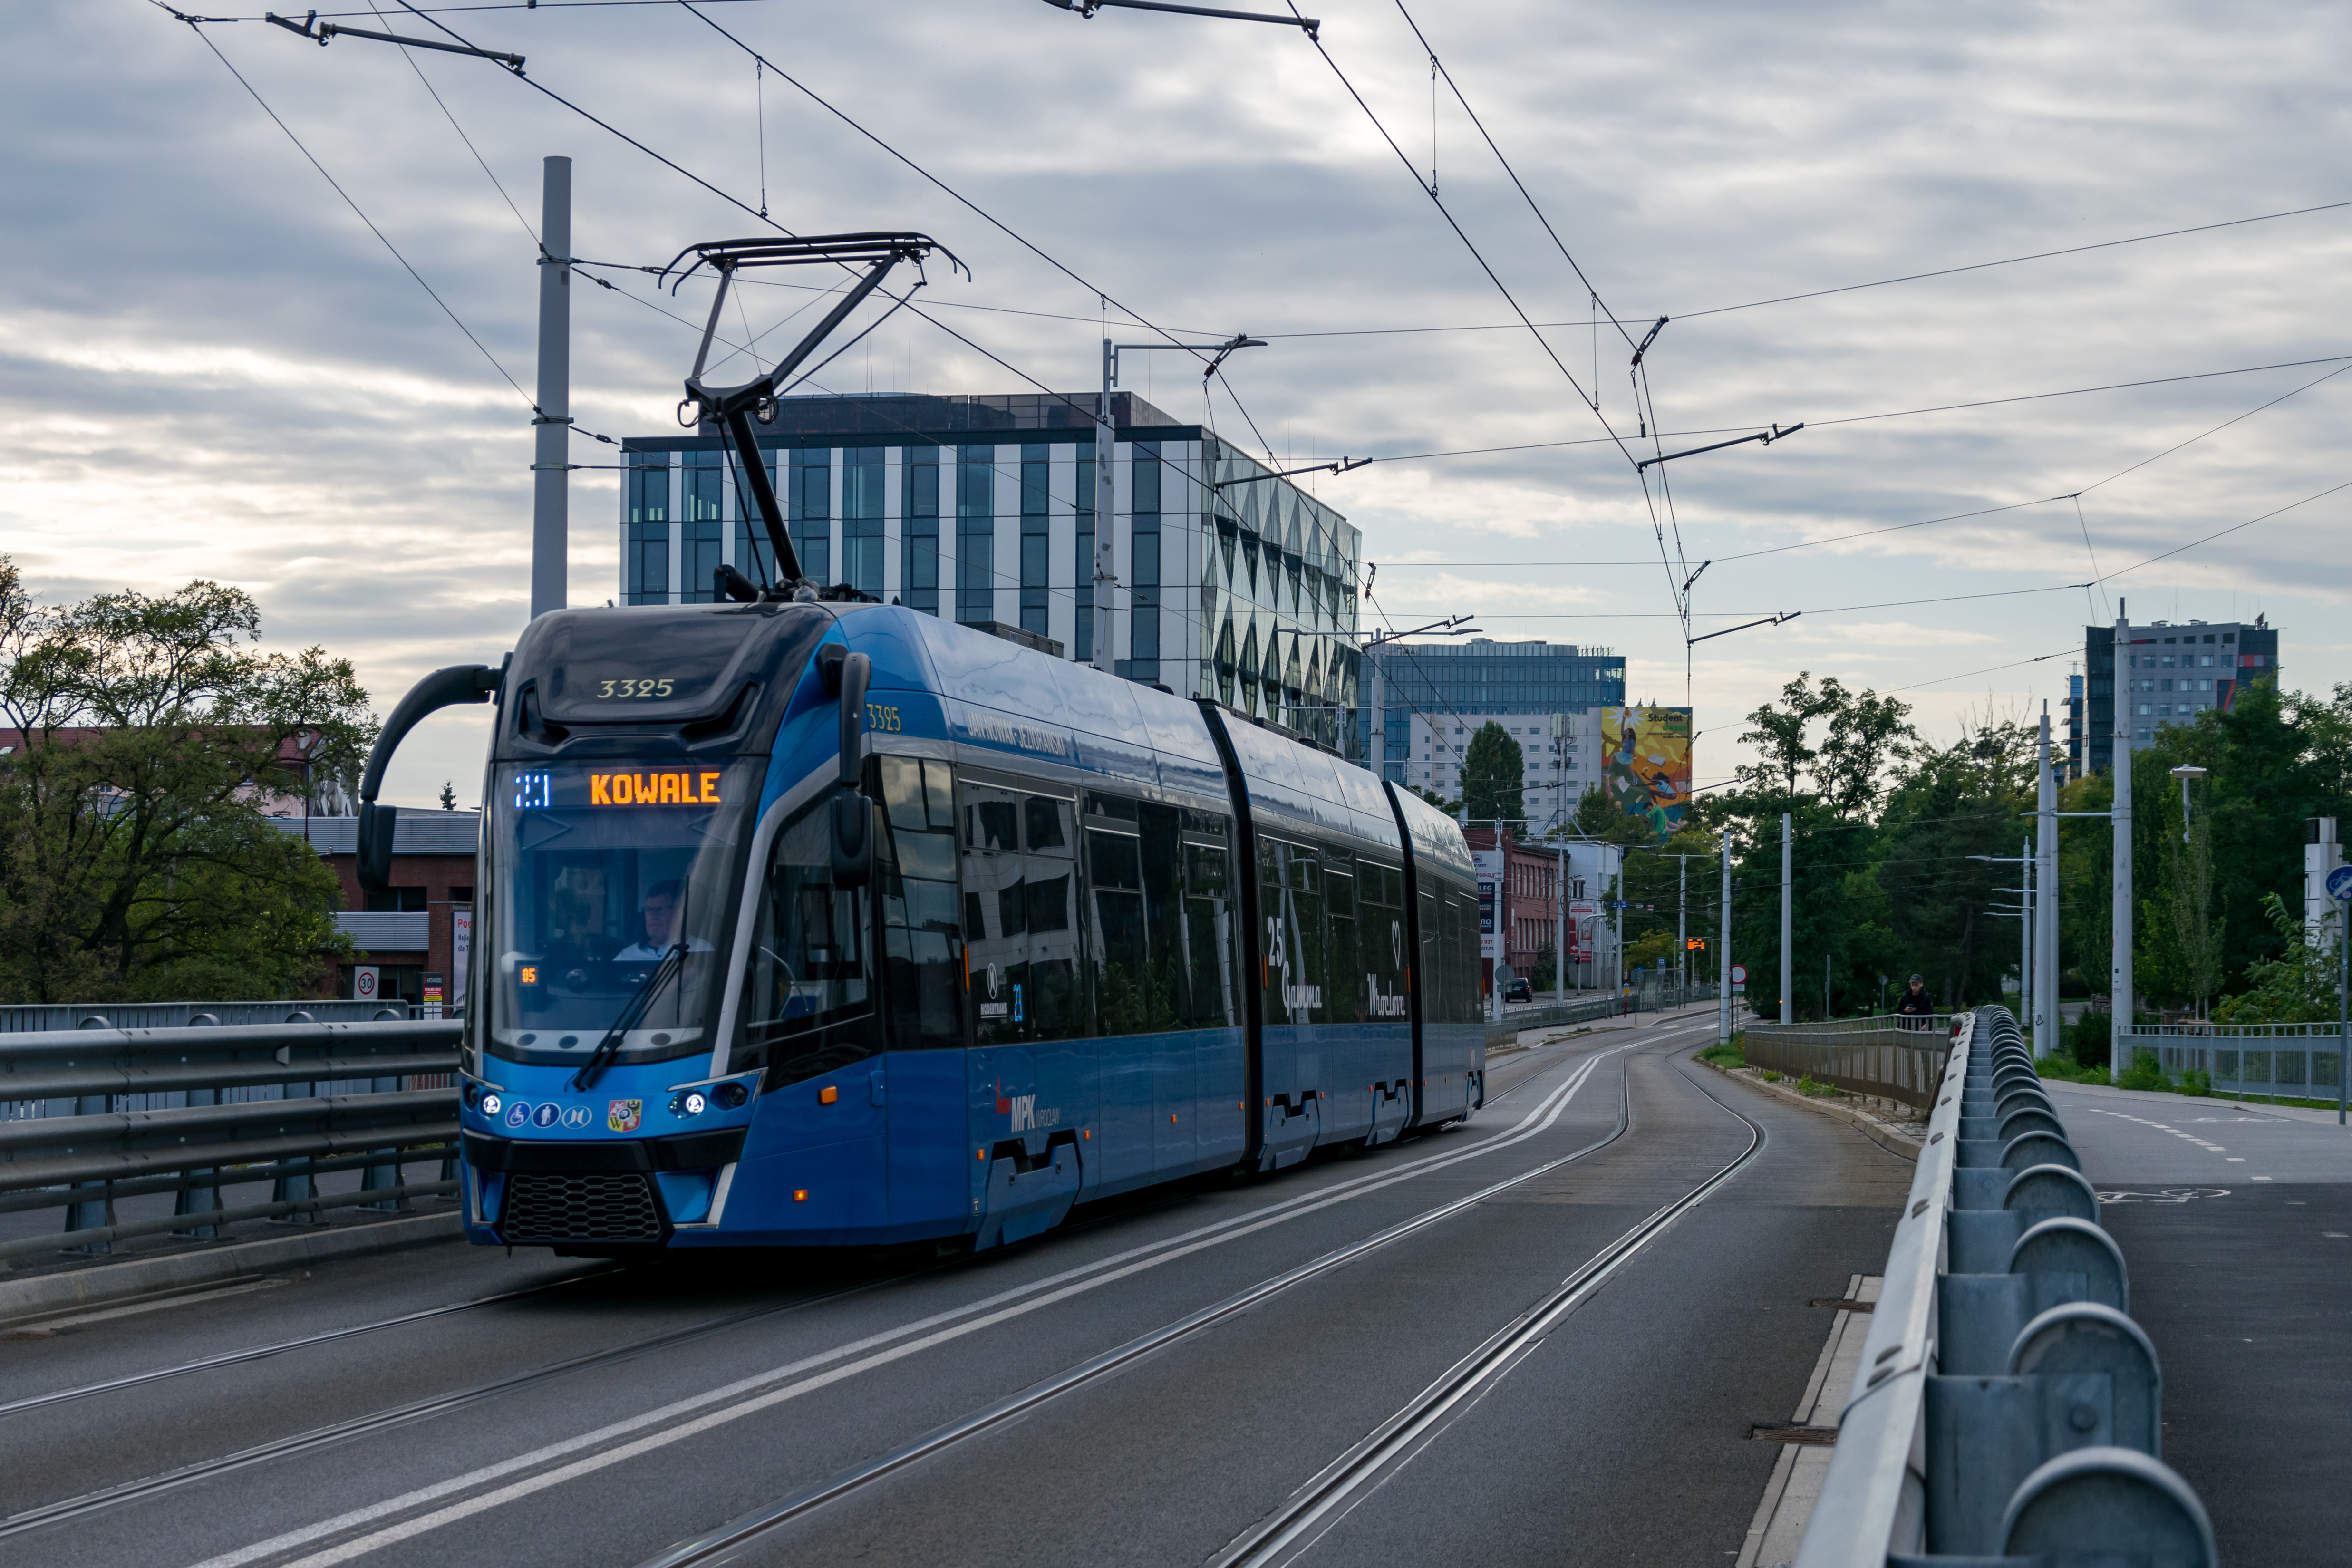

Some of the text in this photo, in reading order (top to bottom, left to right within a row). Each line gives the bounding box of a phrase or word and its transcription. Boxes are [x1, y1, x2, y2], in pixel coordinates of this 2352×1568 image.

[597, 679, 674, 698] 3325
[866, 704, 901, 732] 3325
[967, 710, 986, 739] JAN
[1648, 714, 1683, 722] Student
[591, 772, 721, 804] KOWALE
[1268, 916, 1283, 967] 25
[361, 978, 372, 989] 30
[522, 968, 535, 982] 05
[1282, 961, 1322, 1016] Gamma
[980, 1002, 1007, 1015] MODERTRANS
[1011, 1094, 1036, 1132] MPK
